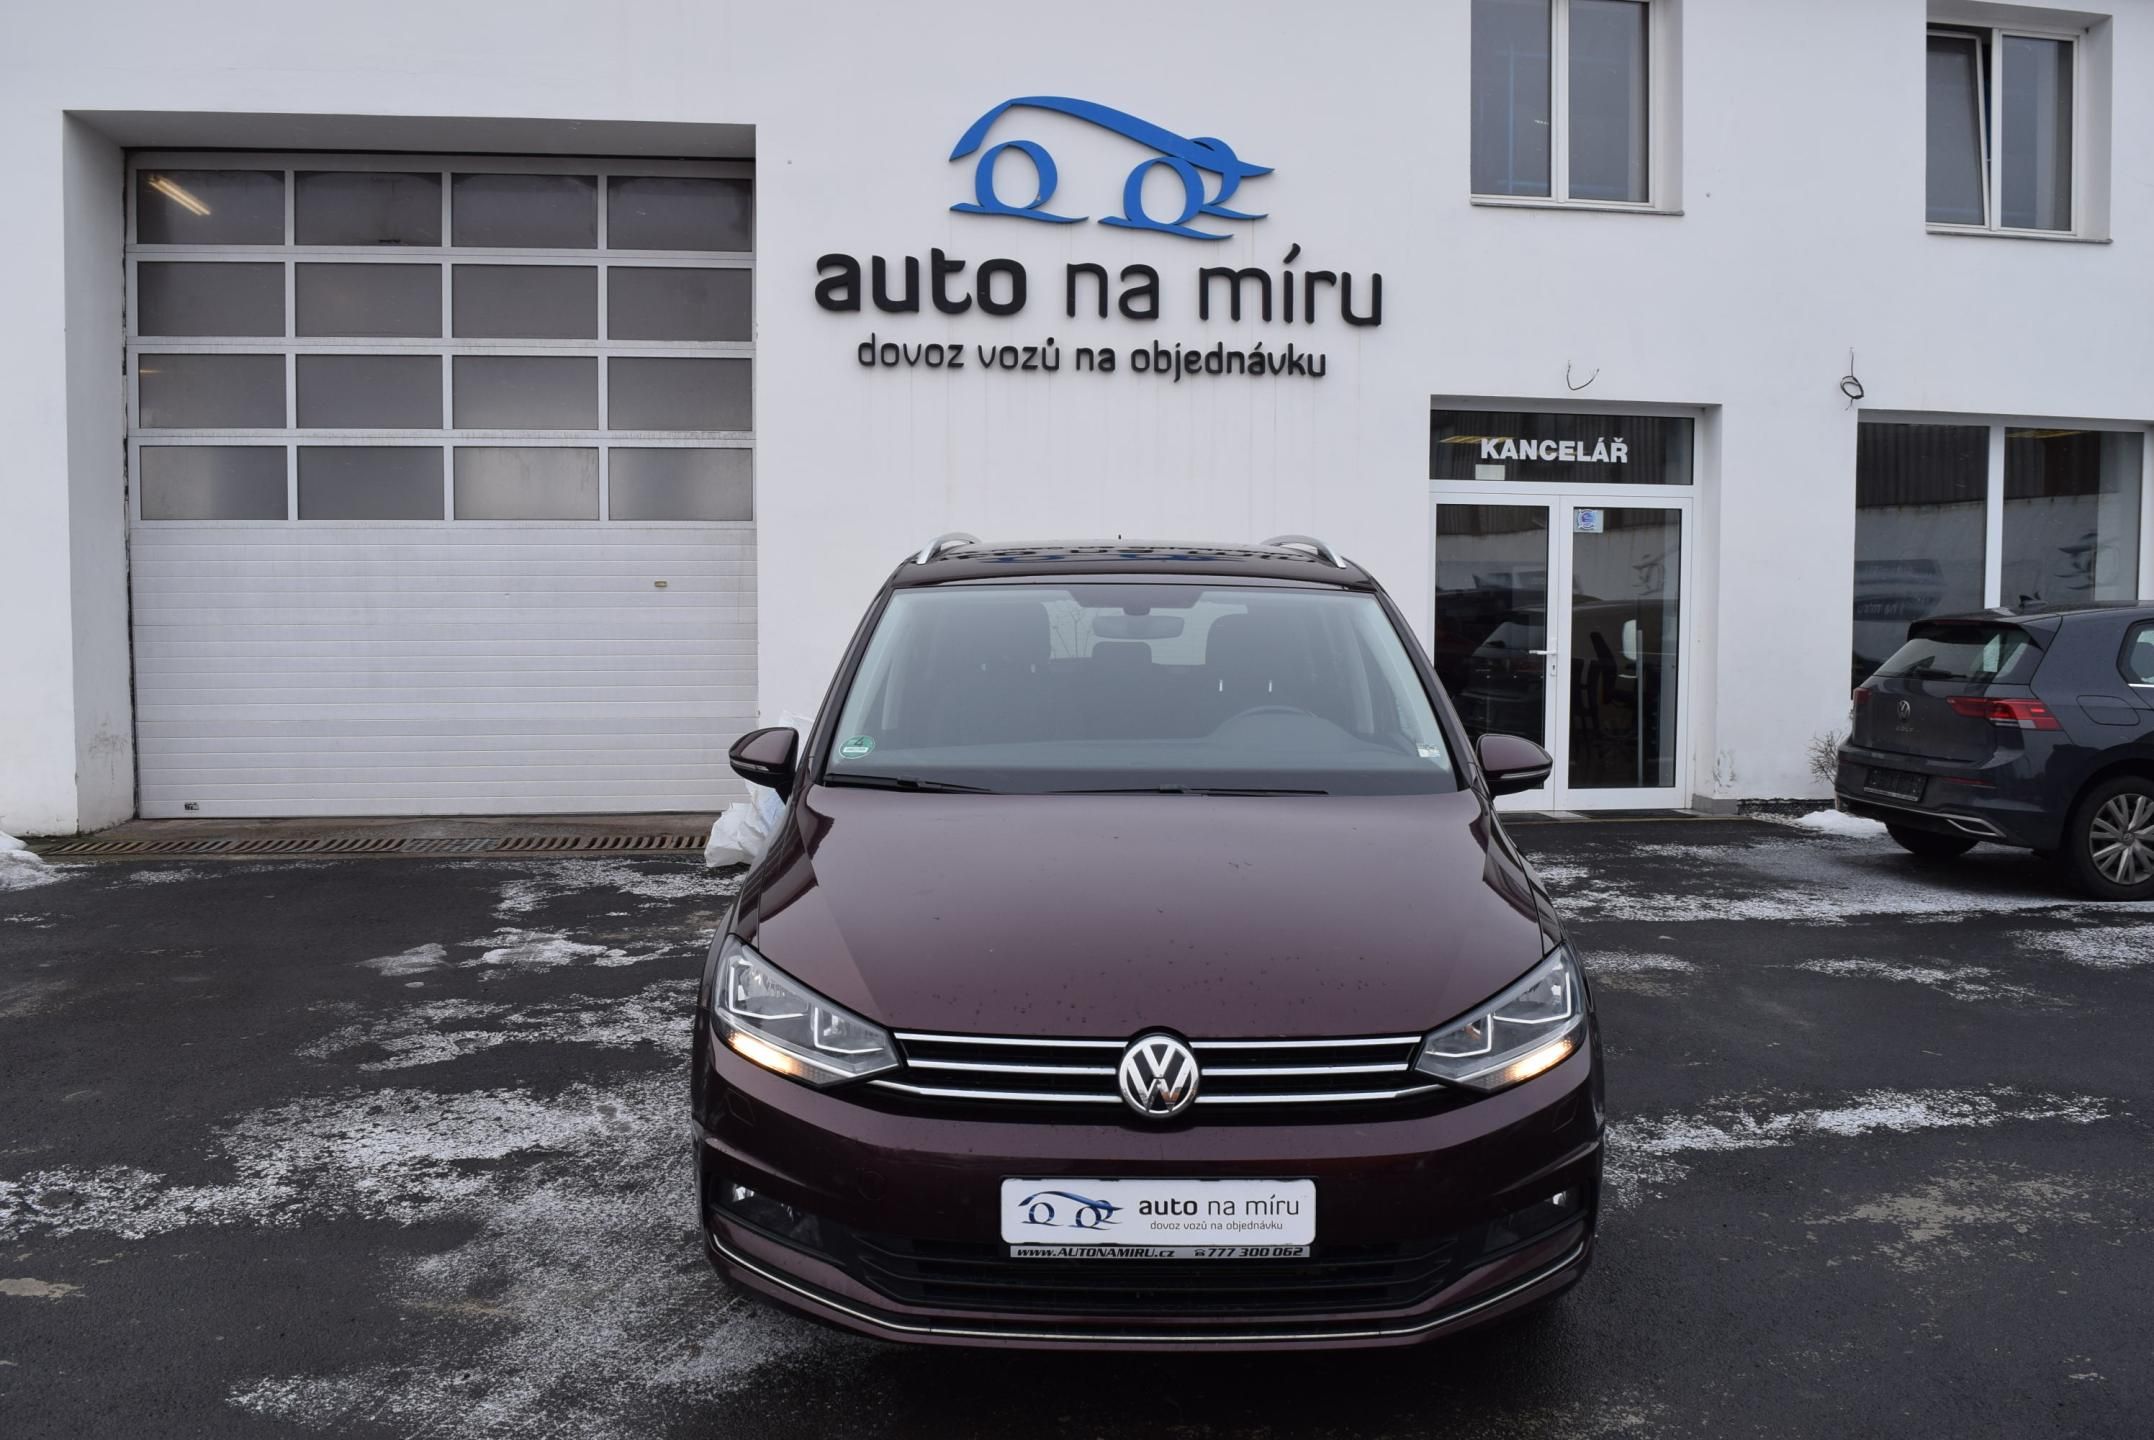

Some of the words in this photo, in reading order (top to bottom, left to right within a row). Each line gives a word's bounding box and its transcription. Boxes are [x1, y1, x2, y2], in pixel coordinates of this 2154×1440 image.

[814, 247, 1028, 316] auto
[1066, 261, 1160, 320] na
[1199, 242, 1383, 327] míru
[857, 332, 965, 369] dovoz
[977, 337, 1060, 372] vozů
[1075, 346, 1116, 373] na
[1130, 340, 1327, 383] objednávku
[1480, 437, 1628, 463] KANCELÁŘ
[1138, 1198, 1198, 1216] auto
[1208, 1200, 1235, 1216] na
[1245, 1194, 1299, 1216] míru
[1150, 1221, 1181, 1230] dovoz
[1183, 1220, 1207, 1230] vozů
[1226, 1220, 1283, 1232] objednávku
[1017, 1247, 1176, 1257] www.AUTONAMIRU.cz
[1208, 1247, 1236, 1257] 777
[1239, 1247, 1270, 1257] 300
[1272, 1247, 1304, 1257] 062
